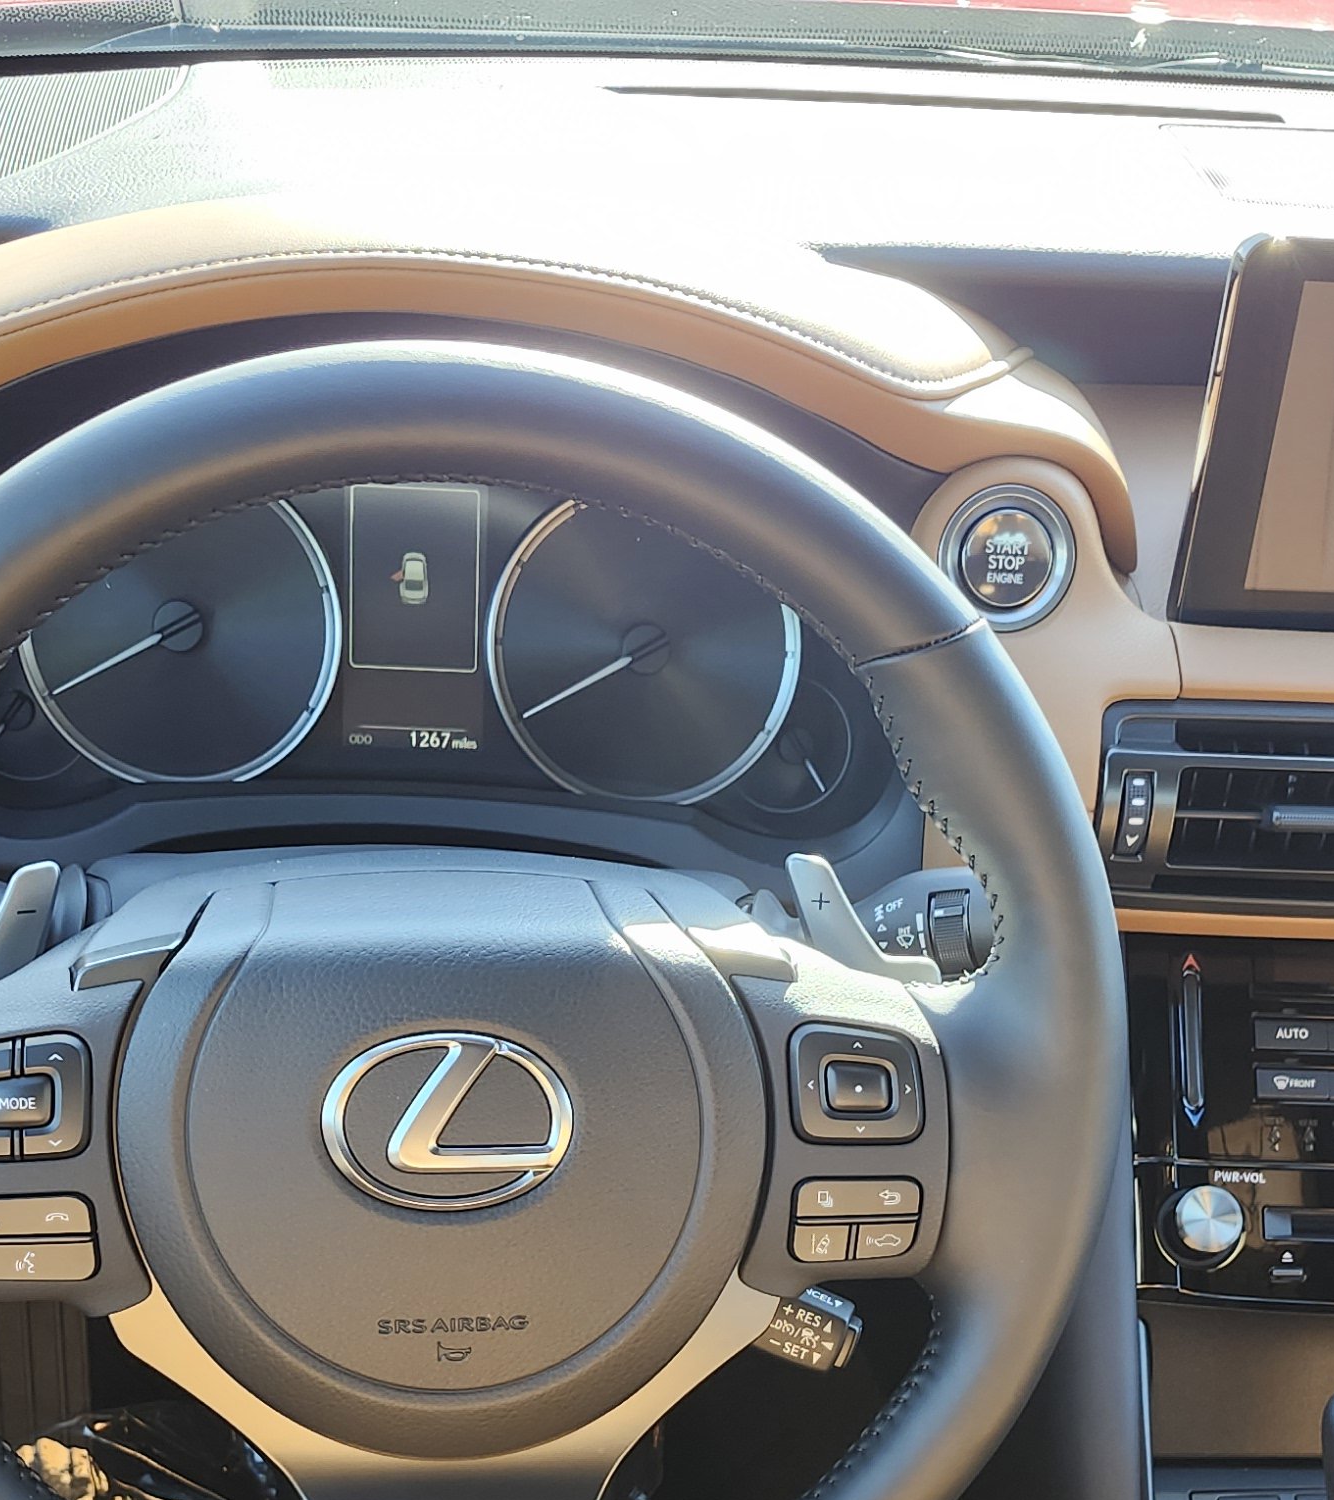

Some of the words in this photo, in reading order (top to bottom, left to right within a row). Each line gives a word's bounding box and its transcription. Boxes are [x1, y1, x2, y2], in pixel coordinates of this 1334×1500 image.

[985, 539, 1031, 555] START
[988, 555, 1025, 570] STOP
[987, 573, 1023, 584] ENGINE
[349, 734, 372, 745] ODO
[410, 731, 451, 748] 1267
[452, 737, 477, 750] miles
[886, 898, 904, 913] OFF
[1276, 1027, 1309, 1039] AUTO
[1289, 1078, 1316, 1089] FRONT
[377, 1319, 427, 1334] SRS
[430, 1315, 529, 1333] AIRBAG
[795, 1308, 822, 1328] RES
[782, 1341, 809, 1360] SET
